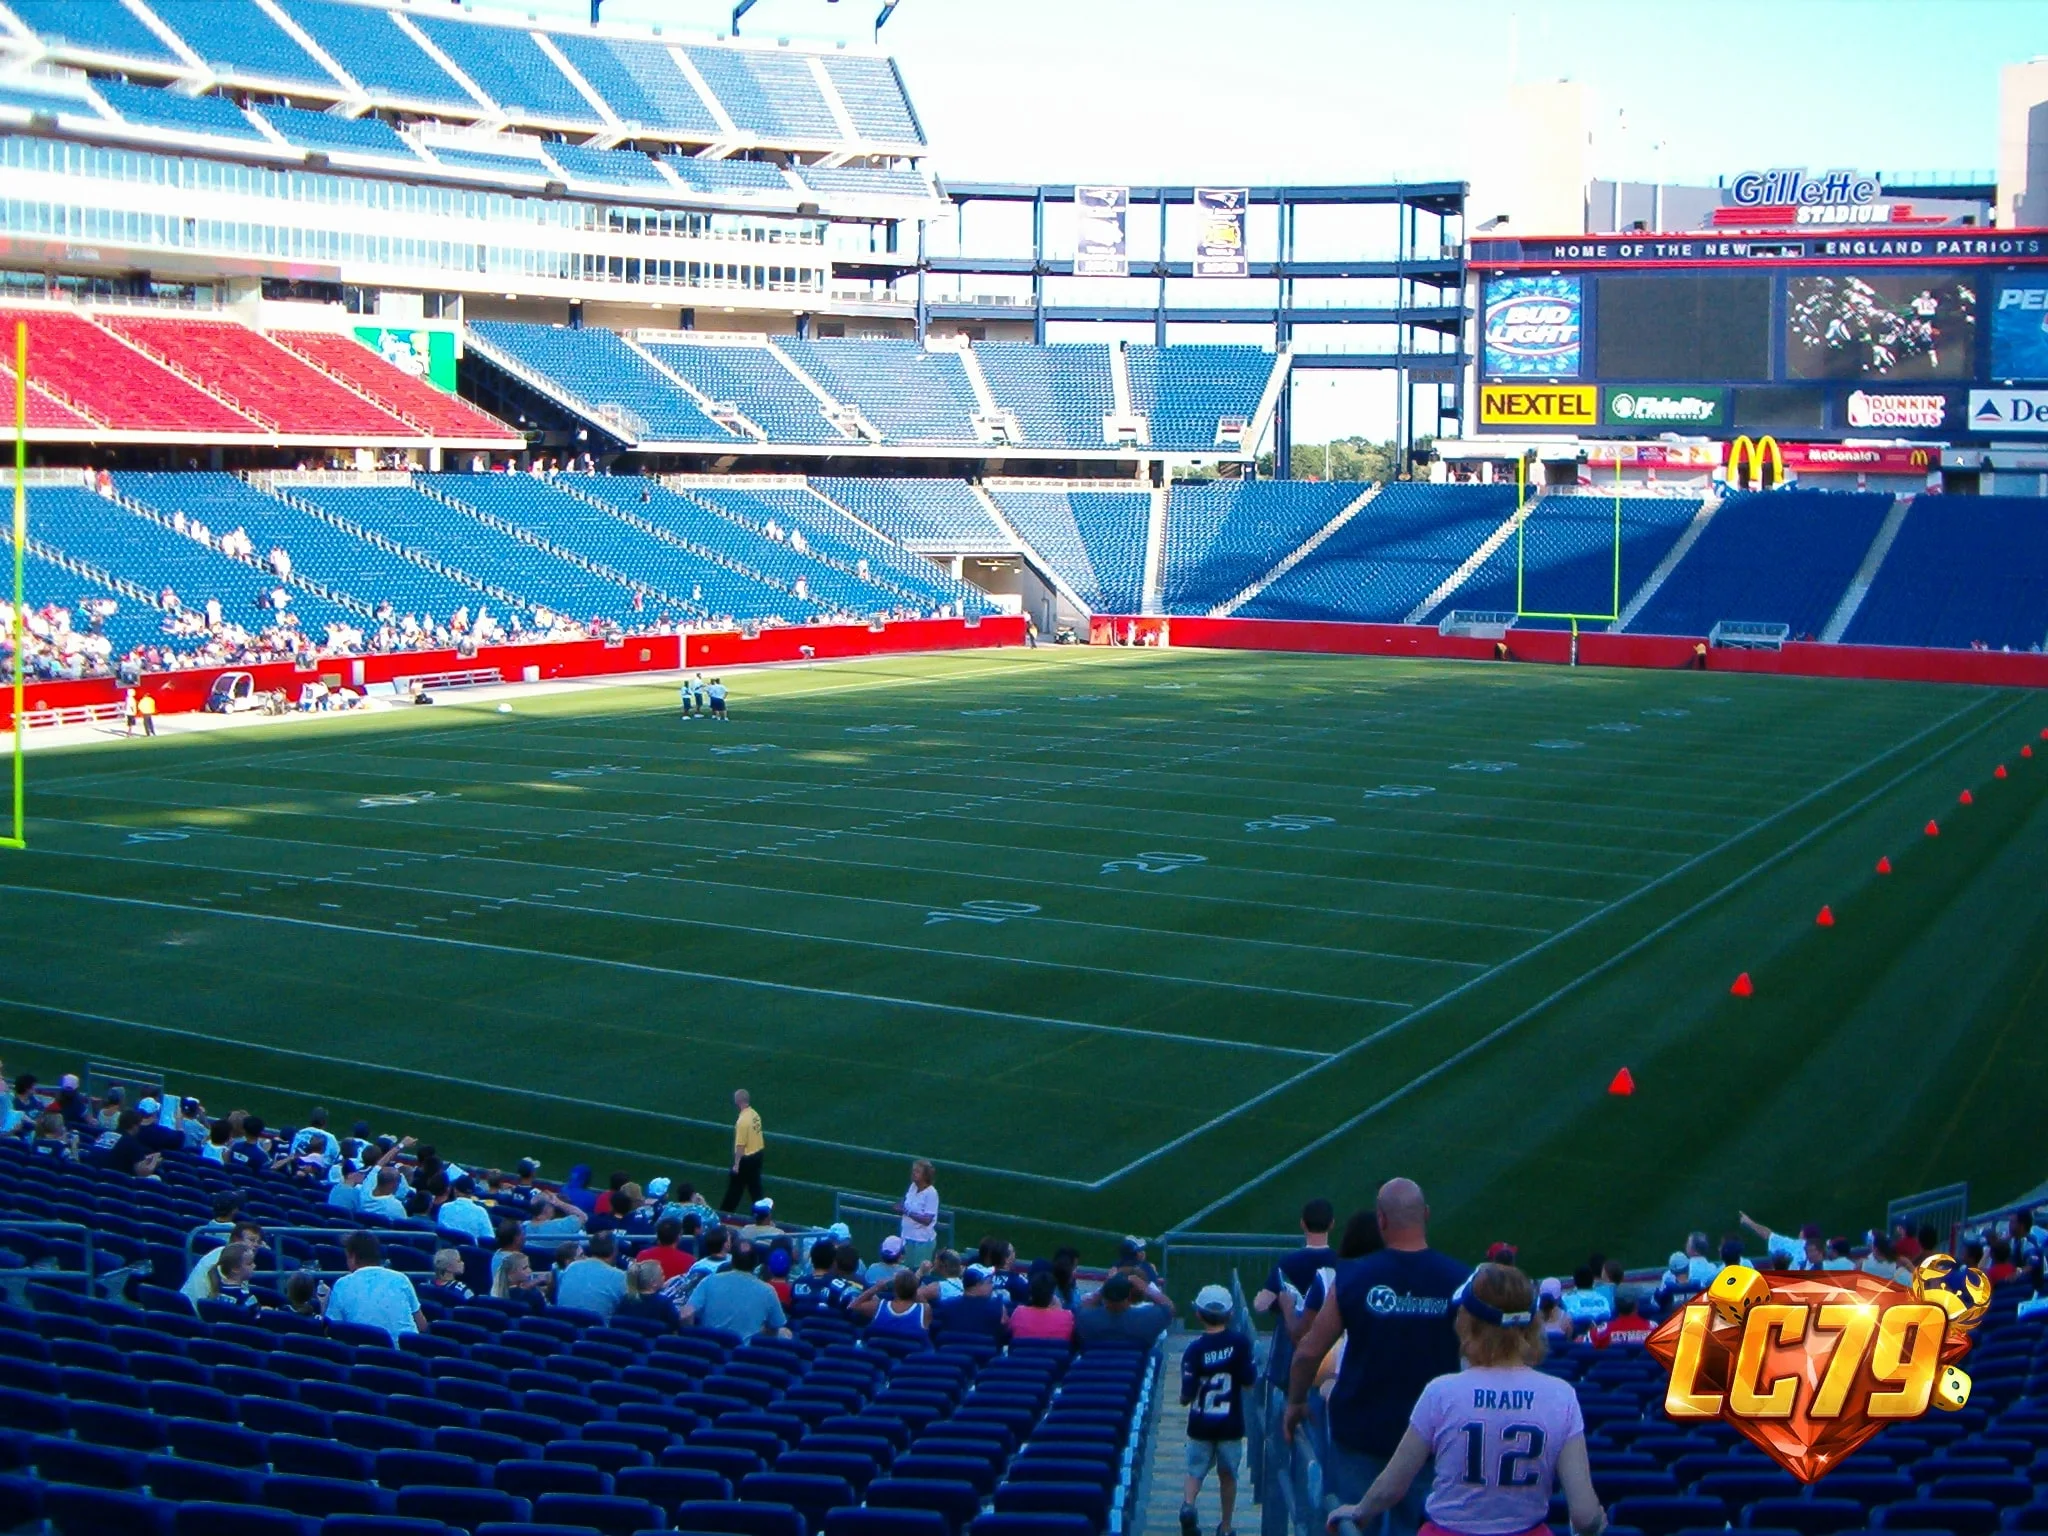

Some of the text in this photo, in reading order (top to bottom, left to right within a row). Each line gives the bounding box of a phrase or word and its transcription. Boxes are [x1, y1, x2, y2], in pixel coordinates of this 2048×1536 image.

[1733, 171, 1877, 206] Gillette
[1796, 205, 1891, 223] STADIUM
[1554, 239, 2040, 258] HOME OF THE NEW ENGLAND PATRIOTS
[1504, 305, 1572, 325] BUD
[1485, 324, 1580, 344] LIGHT
[1485, 393, 1592, 416] NEXTEL
[1872, 411, 1941, 425] DONUTS
[1808, 448, 1881, 462] McDonald's
[1244, 813, 1337, 833] 30
[1099, 851, 1209, 875] 20
[922, 899, 1043, 927] 10
[1192, 1372, 1232, 1415] 12
[1473, 1388, 1535, 1410] BRADY
[1459, 1420, 1546, 1487] 12
